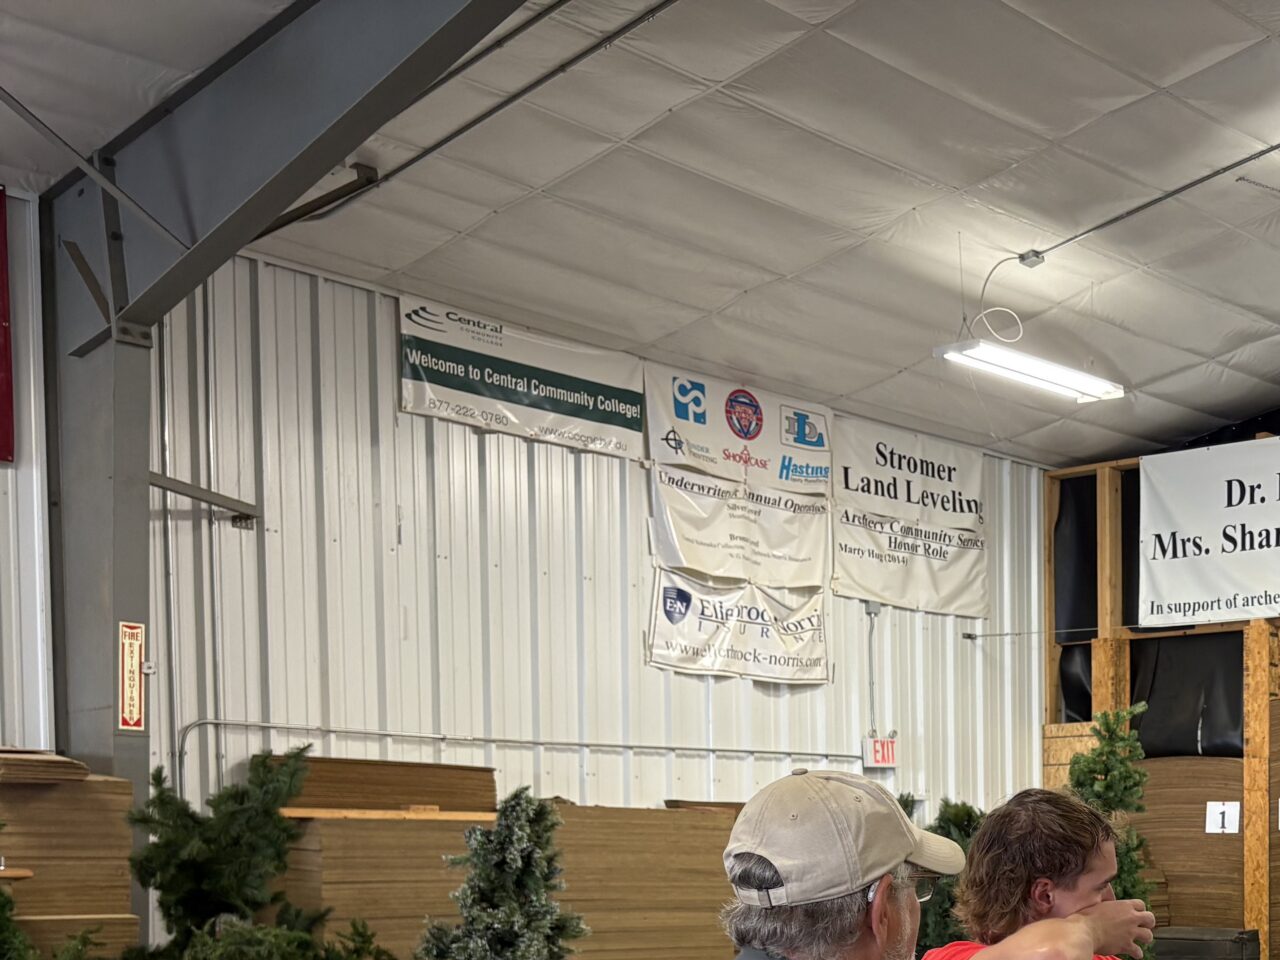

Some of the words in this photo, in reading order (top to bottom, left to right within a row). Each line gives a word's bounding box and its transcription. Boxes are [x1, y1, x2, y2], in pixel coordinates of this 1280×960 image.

[446, 311, 503, 334] Central
[406, 348, 465, 377] Welcome
[468, 365, 481, 381] to
[484, 367, 528, 393] Central
[531, 379, 595, 410] Community
[597, 395, 641, 419] College!
[428, 398, 509, 426] 877-222-0780
[875, 441, 957, 482] Stromer
[841, 466, 898, 500] Land
[906, 479, 984, 524] Leveling
[1224, 479, 1266, 508] Dr.
[890, 521, 955, 546] Community
[838, 543, 865, 559] Marty
[888, 536, 920, 554] Honor
[923, 542, 949, 560] Role
[1150, 532, 1211, 561] Mrs.
[1149, 600, 1164, 615] In
[1167, 596, 1222, 617] support
[1225, 594, 1238, 610] of
[123, 631, 141, 641] FIRE
[128, 641, 136, 722] EXTINGUISHER
[873, 739, 896, 764] EXIT
[1219, 810, 1227, 829] 1
